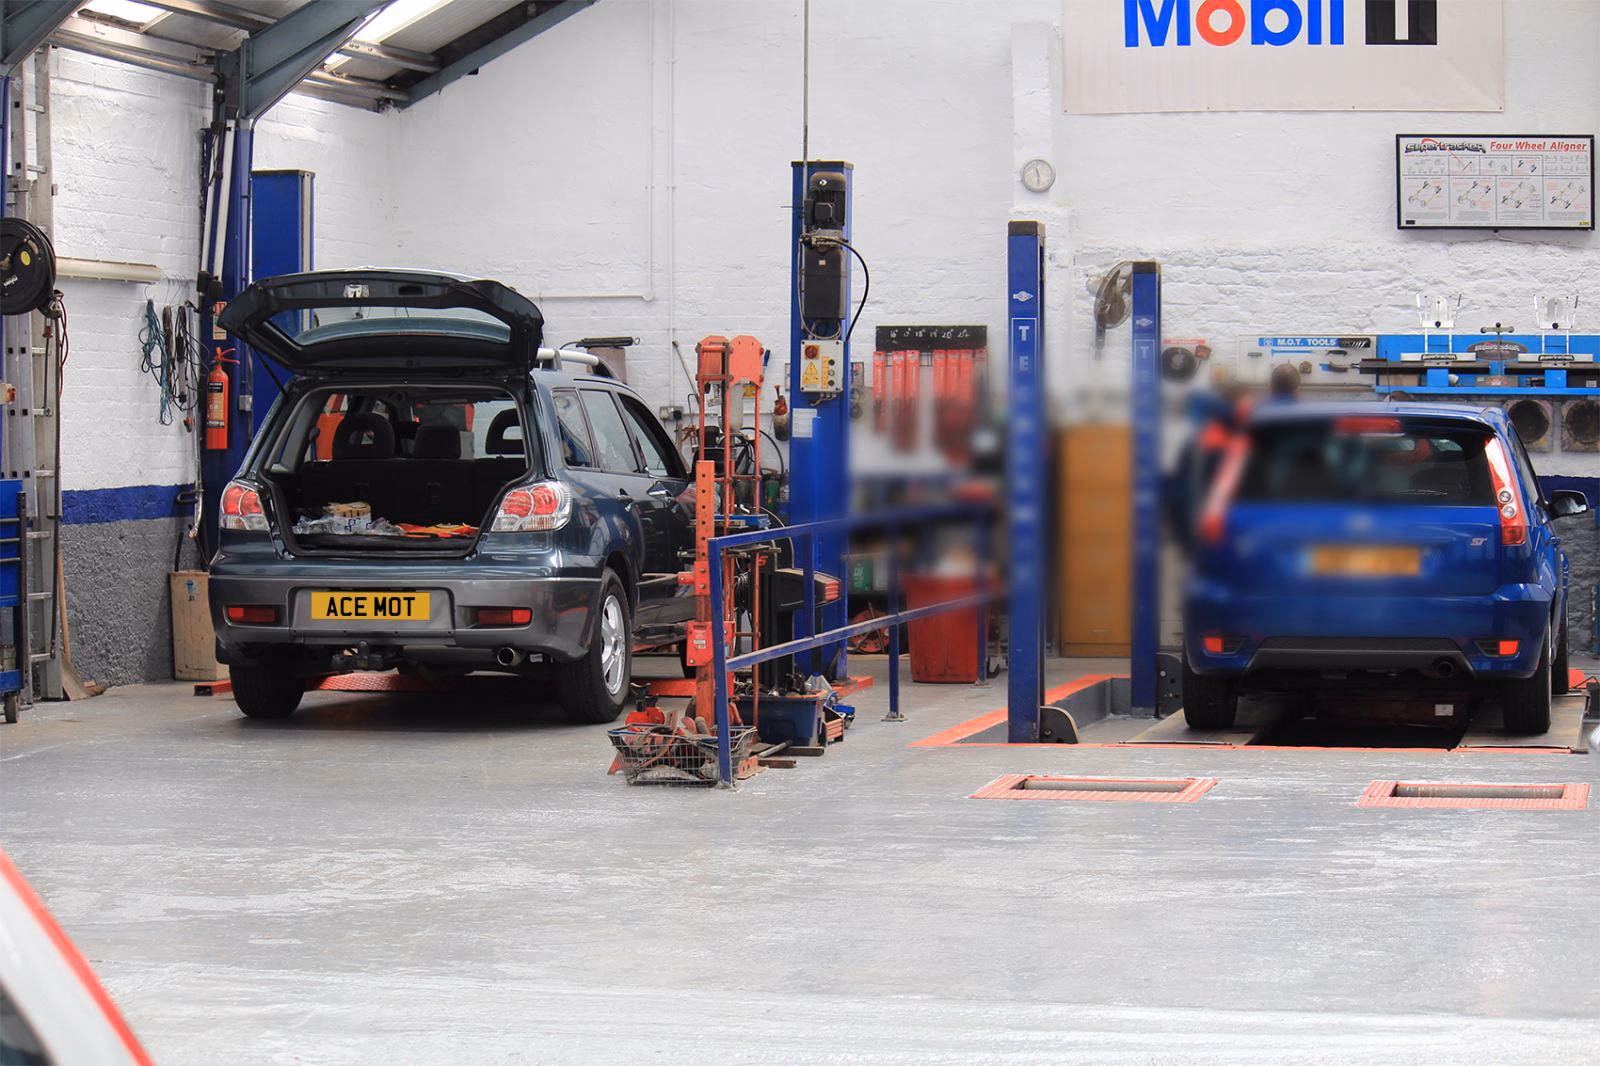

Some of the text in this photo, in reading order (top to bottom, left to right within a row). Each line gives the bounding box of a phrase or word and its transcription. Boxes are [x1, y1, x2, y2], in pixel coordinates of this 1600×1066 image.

[1124, 0, 1344, 47] Mobil
[1490, 141, 1513, 150] Four
[1515, 141, 1546, 150] Wheel
[1550, 141, 1587, 152] Aligner
[1277, 337, 1337, 346] M.O.T. TOOLS
[1470, 537, 1489, 546] ST
[326, 596, 416, 617] ACE MOT
